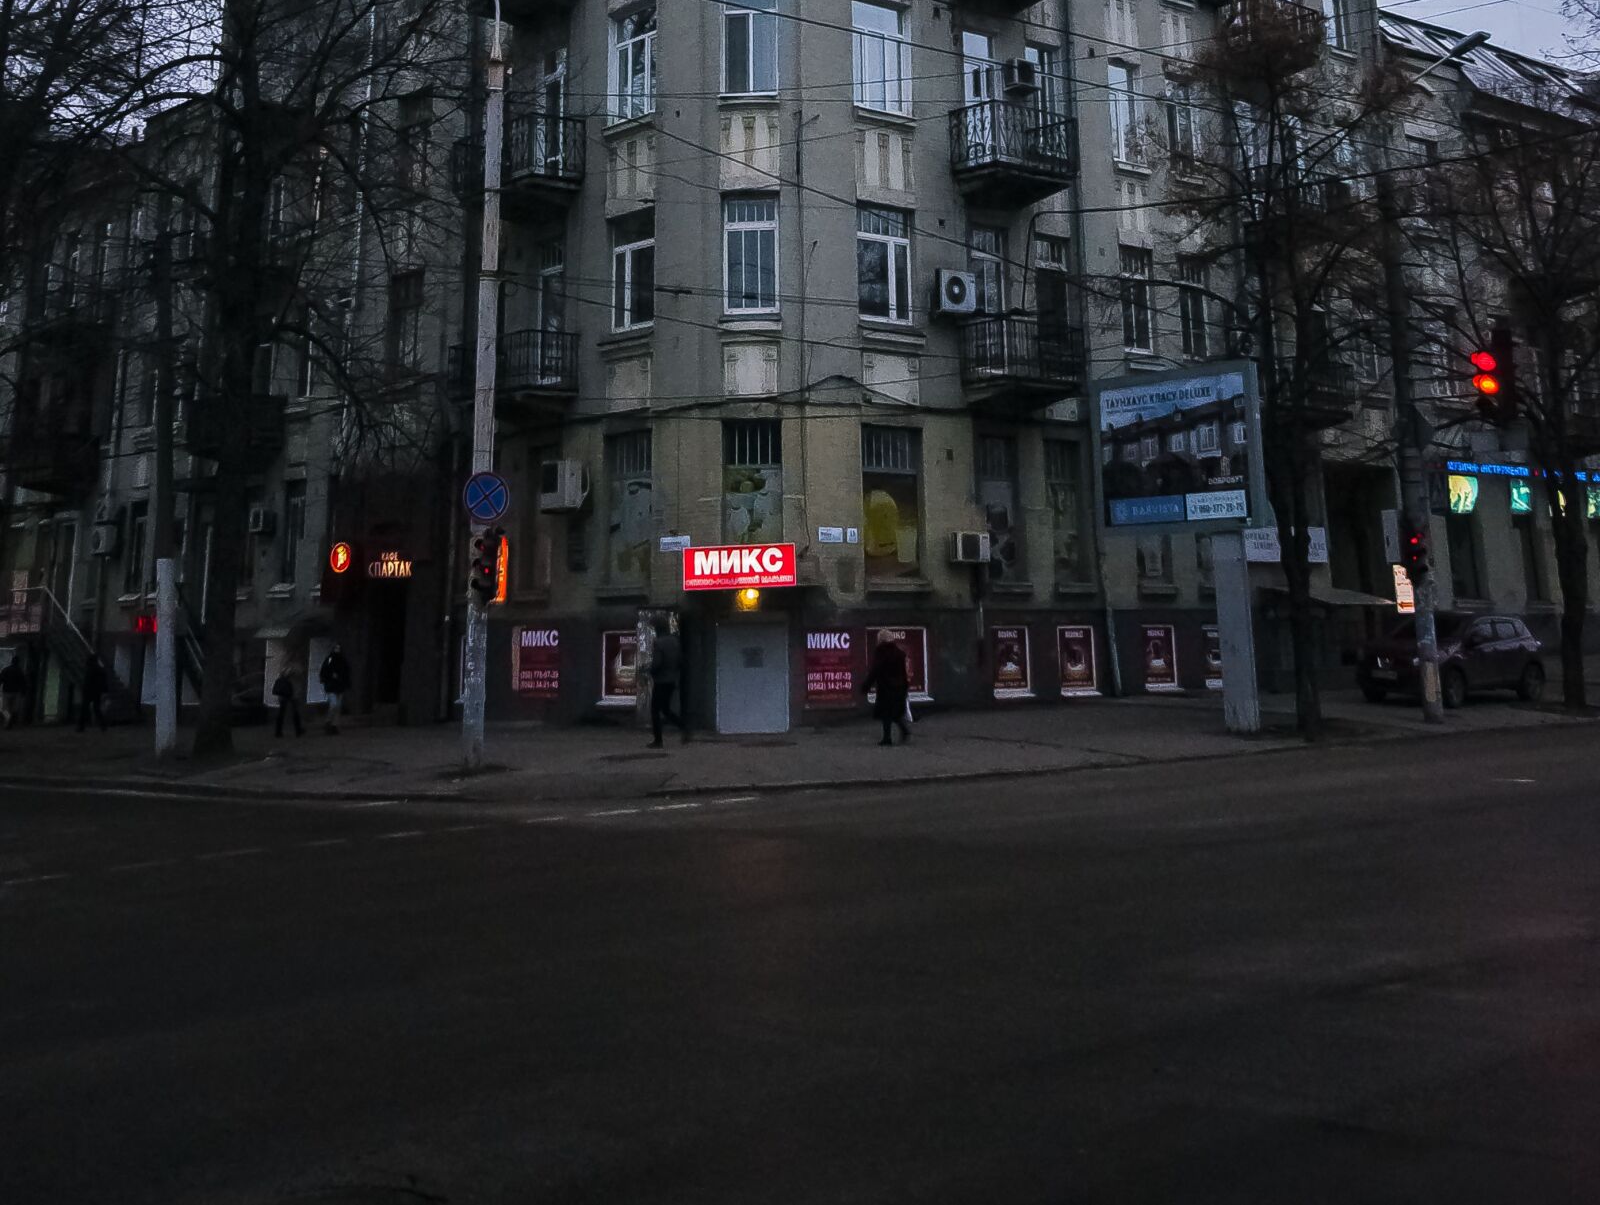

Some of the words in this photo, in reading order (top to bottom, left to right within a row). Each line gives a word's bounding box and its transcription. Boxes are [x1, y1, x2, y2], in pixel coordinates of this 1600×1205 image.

[1106, 395, 1147, 409] ТАУНХАУС
[1149, 390, 1176, 403] КЛАСУ
[1178, 386, 1211, 400] DELUXE
[381, 552, 399, 561] КАФЕ
[694, 548, 784, 576] МИКС
[368, 561, 412, 577] СПАРТАК
[521, 630, 560, 647] МИКС
[807, 632, 851, 649] МИКС
